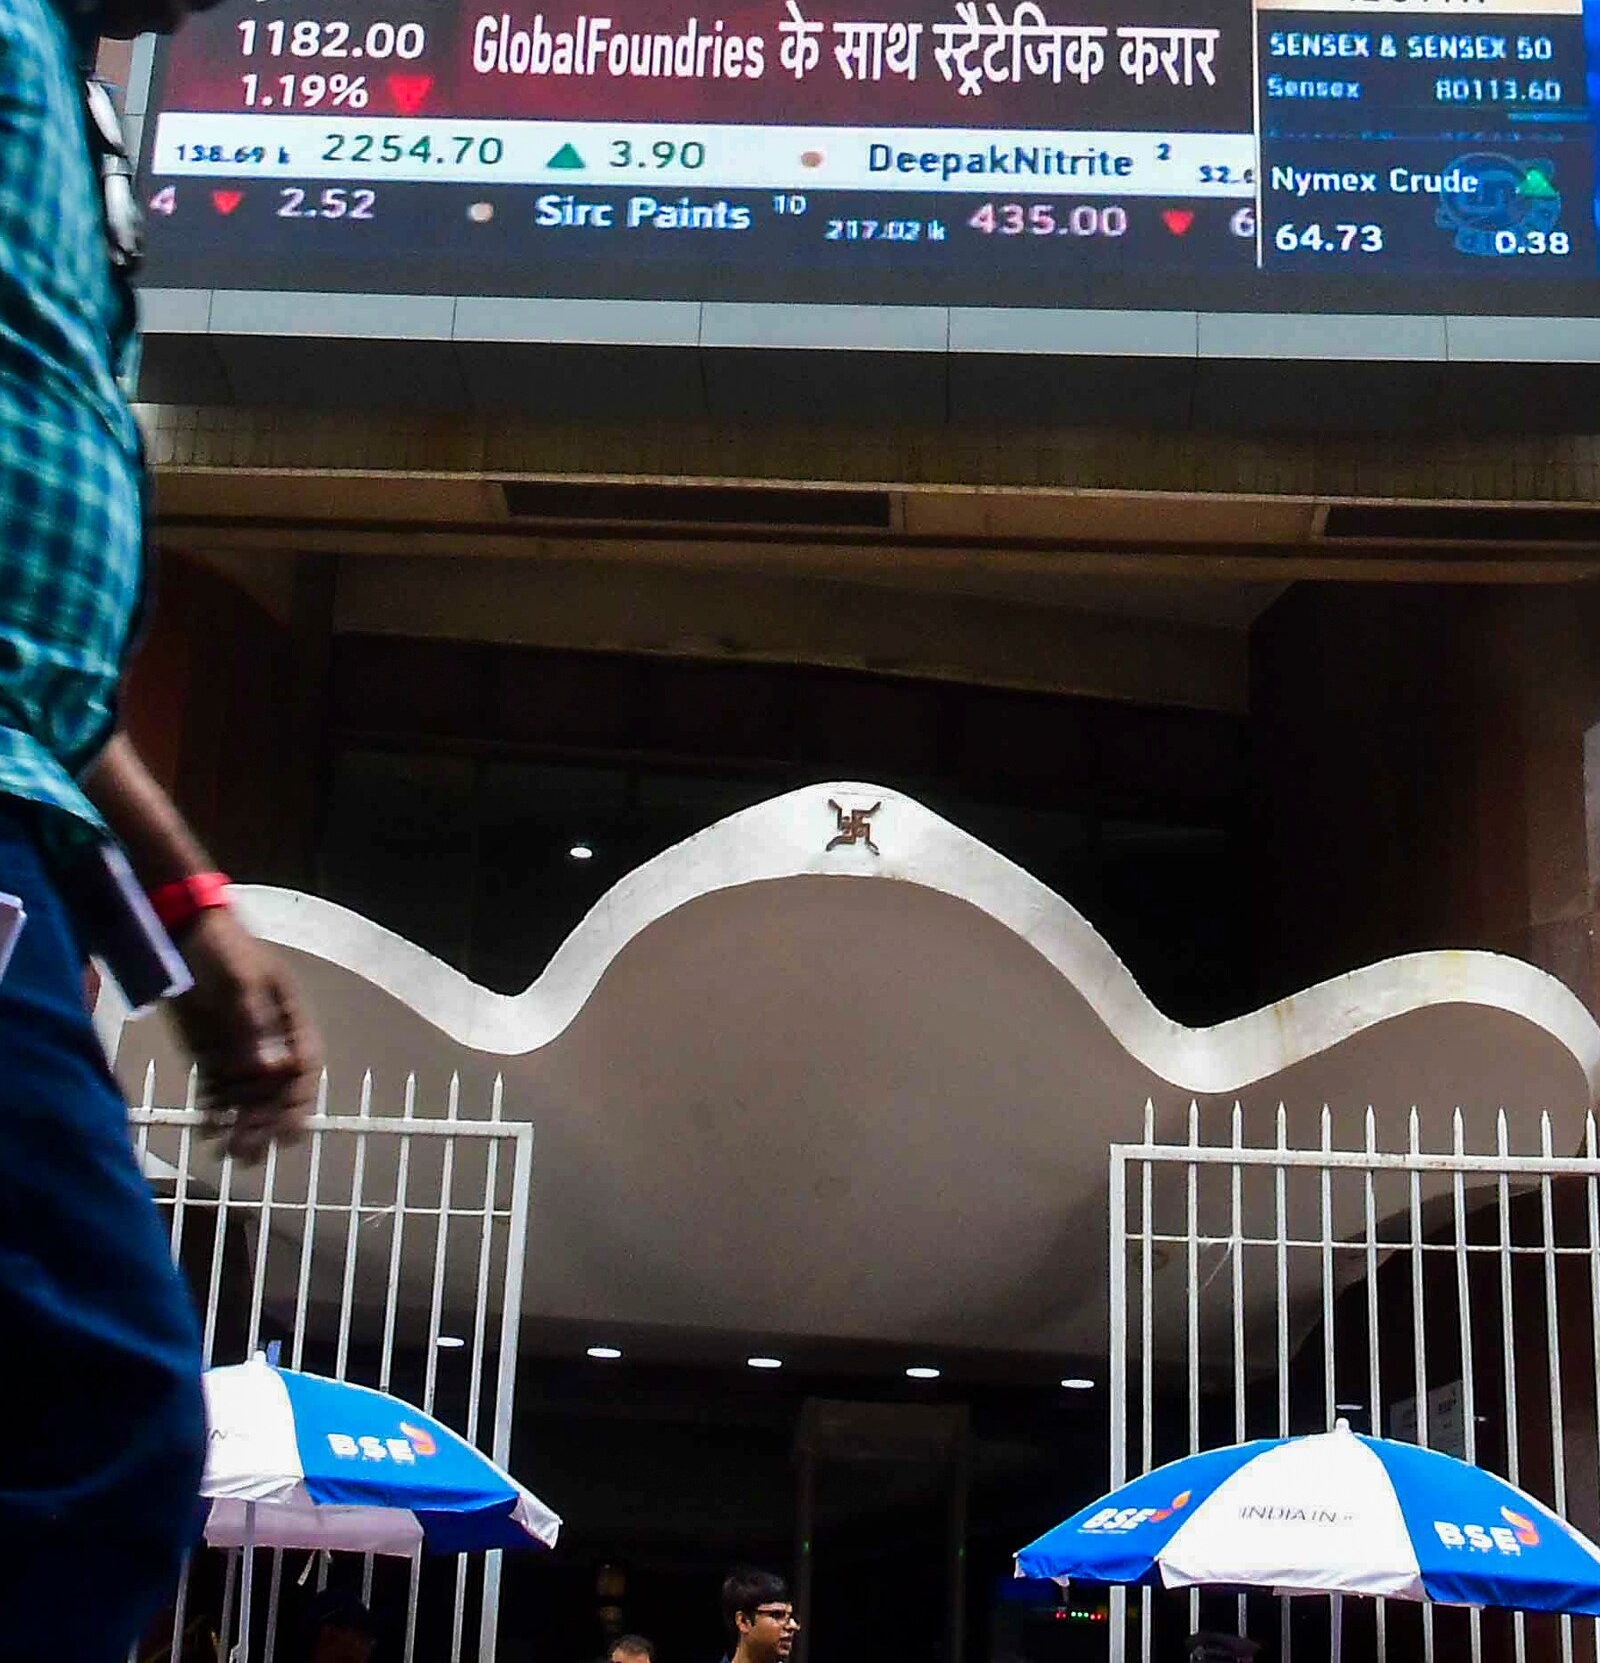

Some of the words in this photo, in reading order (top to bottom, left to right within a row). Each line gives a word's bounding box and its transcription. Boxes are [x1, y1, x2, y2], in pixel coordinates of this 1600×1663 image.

[237, 19, 426, 60] 1182.00
[473, 14, 765, 78] GlobalFoundries
[778, 0, 823, 79] के
[832, 21, 923, 82] साथ
[1116, 26, 1221, 88] करार
[1269, 32, 1371, 58] SENSEX
[1406, 34, 1508, 60] SENSEX
[1516, 36, 1553, 61] 50
[241, 73, 369, 108] 1.19%
[1266, 73, 1362, 100] Sensex
[321, 134, 504, 166] 2254.70
[608, 139, 707, 170] 3.90
[868, 142, 1135, 182] DeepakNitrite
[1270, 166, 1376, 197] Nymex
[1389, 166, 1479, 195] Crude
[276, 188, 377, 220] 2.52
[535, 196, 612, 227] Sirc
[627, 198, 751, 231] Paints
[968, 202, 1129, 238] 435.00
[1274, 223, 1384, 254] 64.73
[1493, 231, 1571, 256] 0.38
[327, 1433, 416, 1465] BSE
[1081, 1507, 1158, 1530] BSE
[1433, 1521, 1522, 1551] BSE
